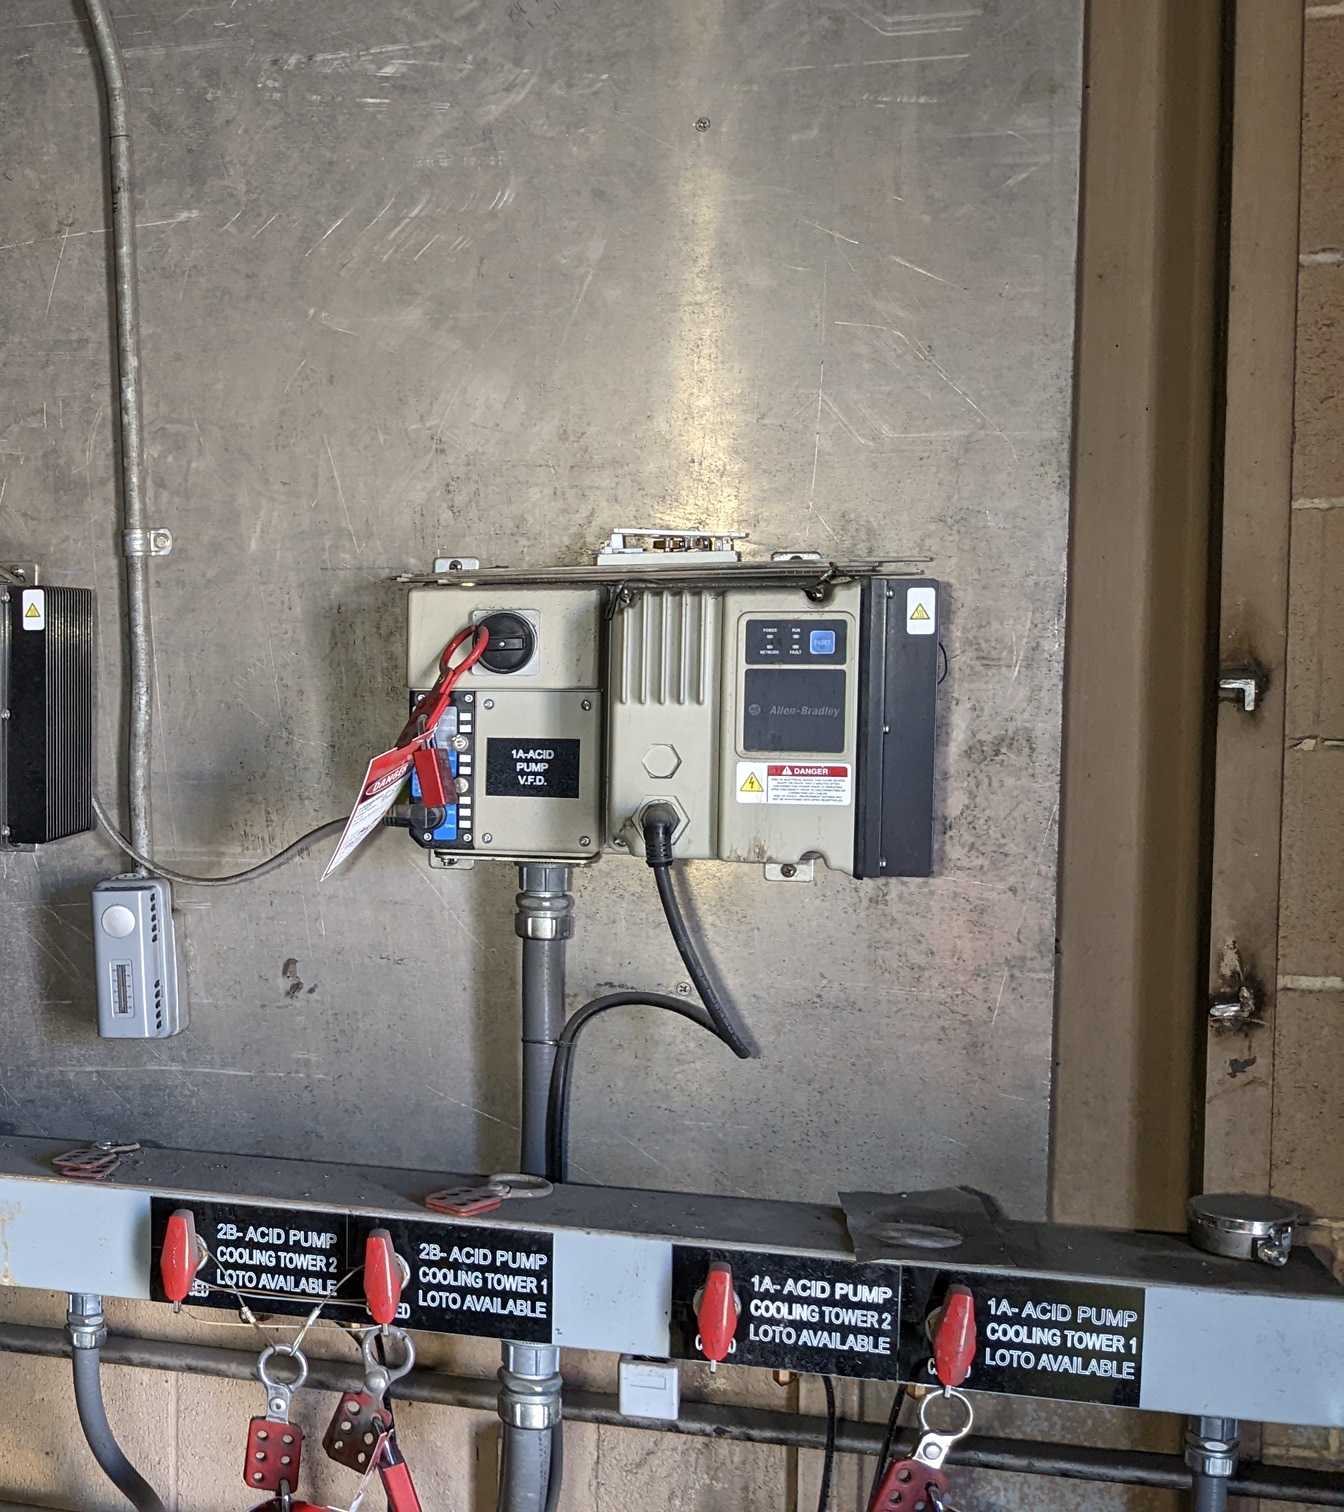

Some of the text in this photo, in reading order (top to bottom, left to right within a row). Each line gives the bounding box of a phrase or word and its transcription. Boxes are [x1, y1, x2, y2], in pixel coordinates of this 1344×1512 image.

[770, 705, 840, 717] Allen-Bradley
[512, 749, 554, 759] 1A-ACID
[516, 762, 549, 772] PUMP
[518, 775, 547, 785] V.F.D.
[217, 1223, 337, 1249] 2B- ACID PUMP
[217, 1246, 337, 1273] COOLING TOWER 2
[419, 1243, 547, 1271] 2B- ACID PUMP
[217, 1269, 337, 1296] LOTO AVAILABLE
[419, 1266, 547, 1294] COOLING TOWER 1
[751, 1275, 892, 1304] 1A- ACID PUMP
[418, 1290, 547, 1319] LOTO AVAILABLE
[749, 1299, 892, 1330] COOLING TOWER 2
[987, 1297, 1138, 1328] 1A- ACID PUMP
[749, 1323, 796, 1344] LOTO
[798, 1329, 890, 1355] AVAILABLE
[986, 1322, 1137, 1354] COOLING TOWER 1
[985, 1348, 1036, 1369] LOTO
[1037, 1353, 1135, 1380] AVAILABLE
